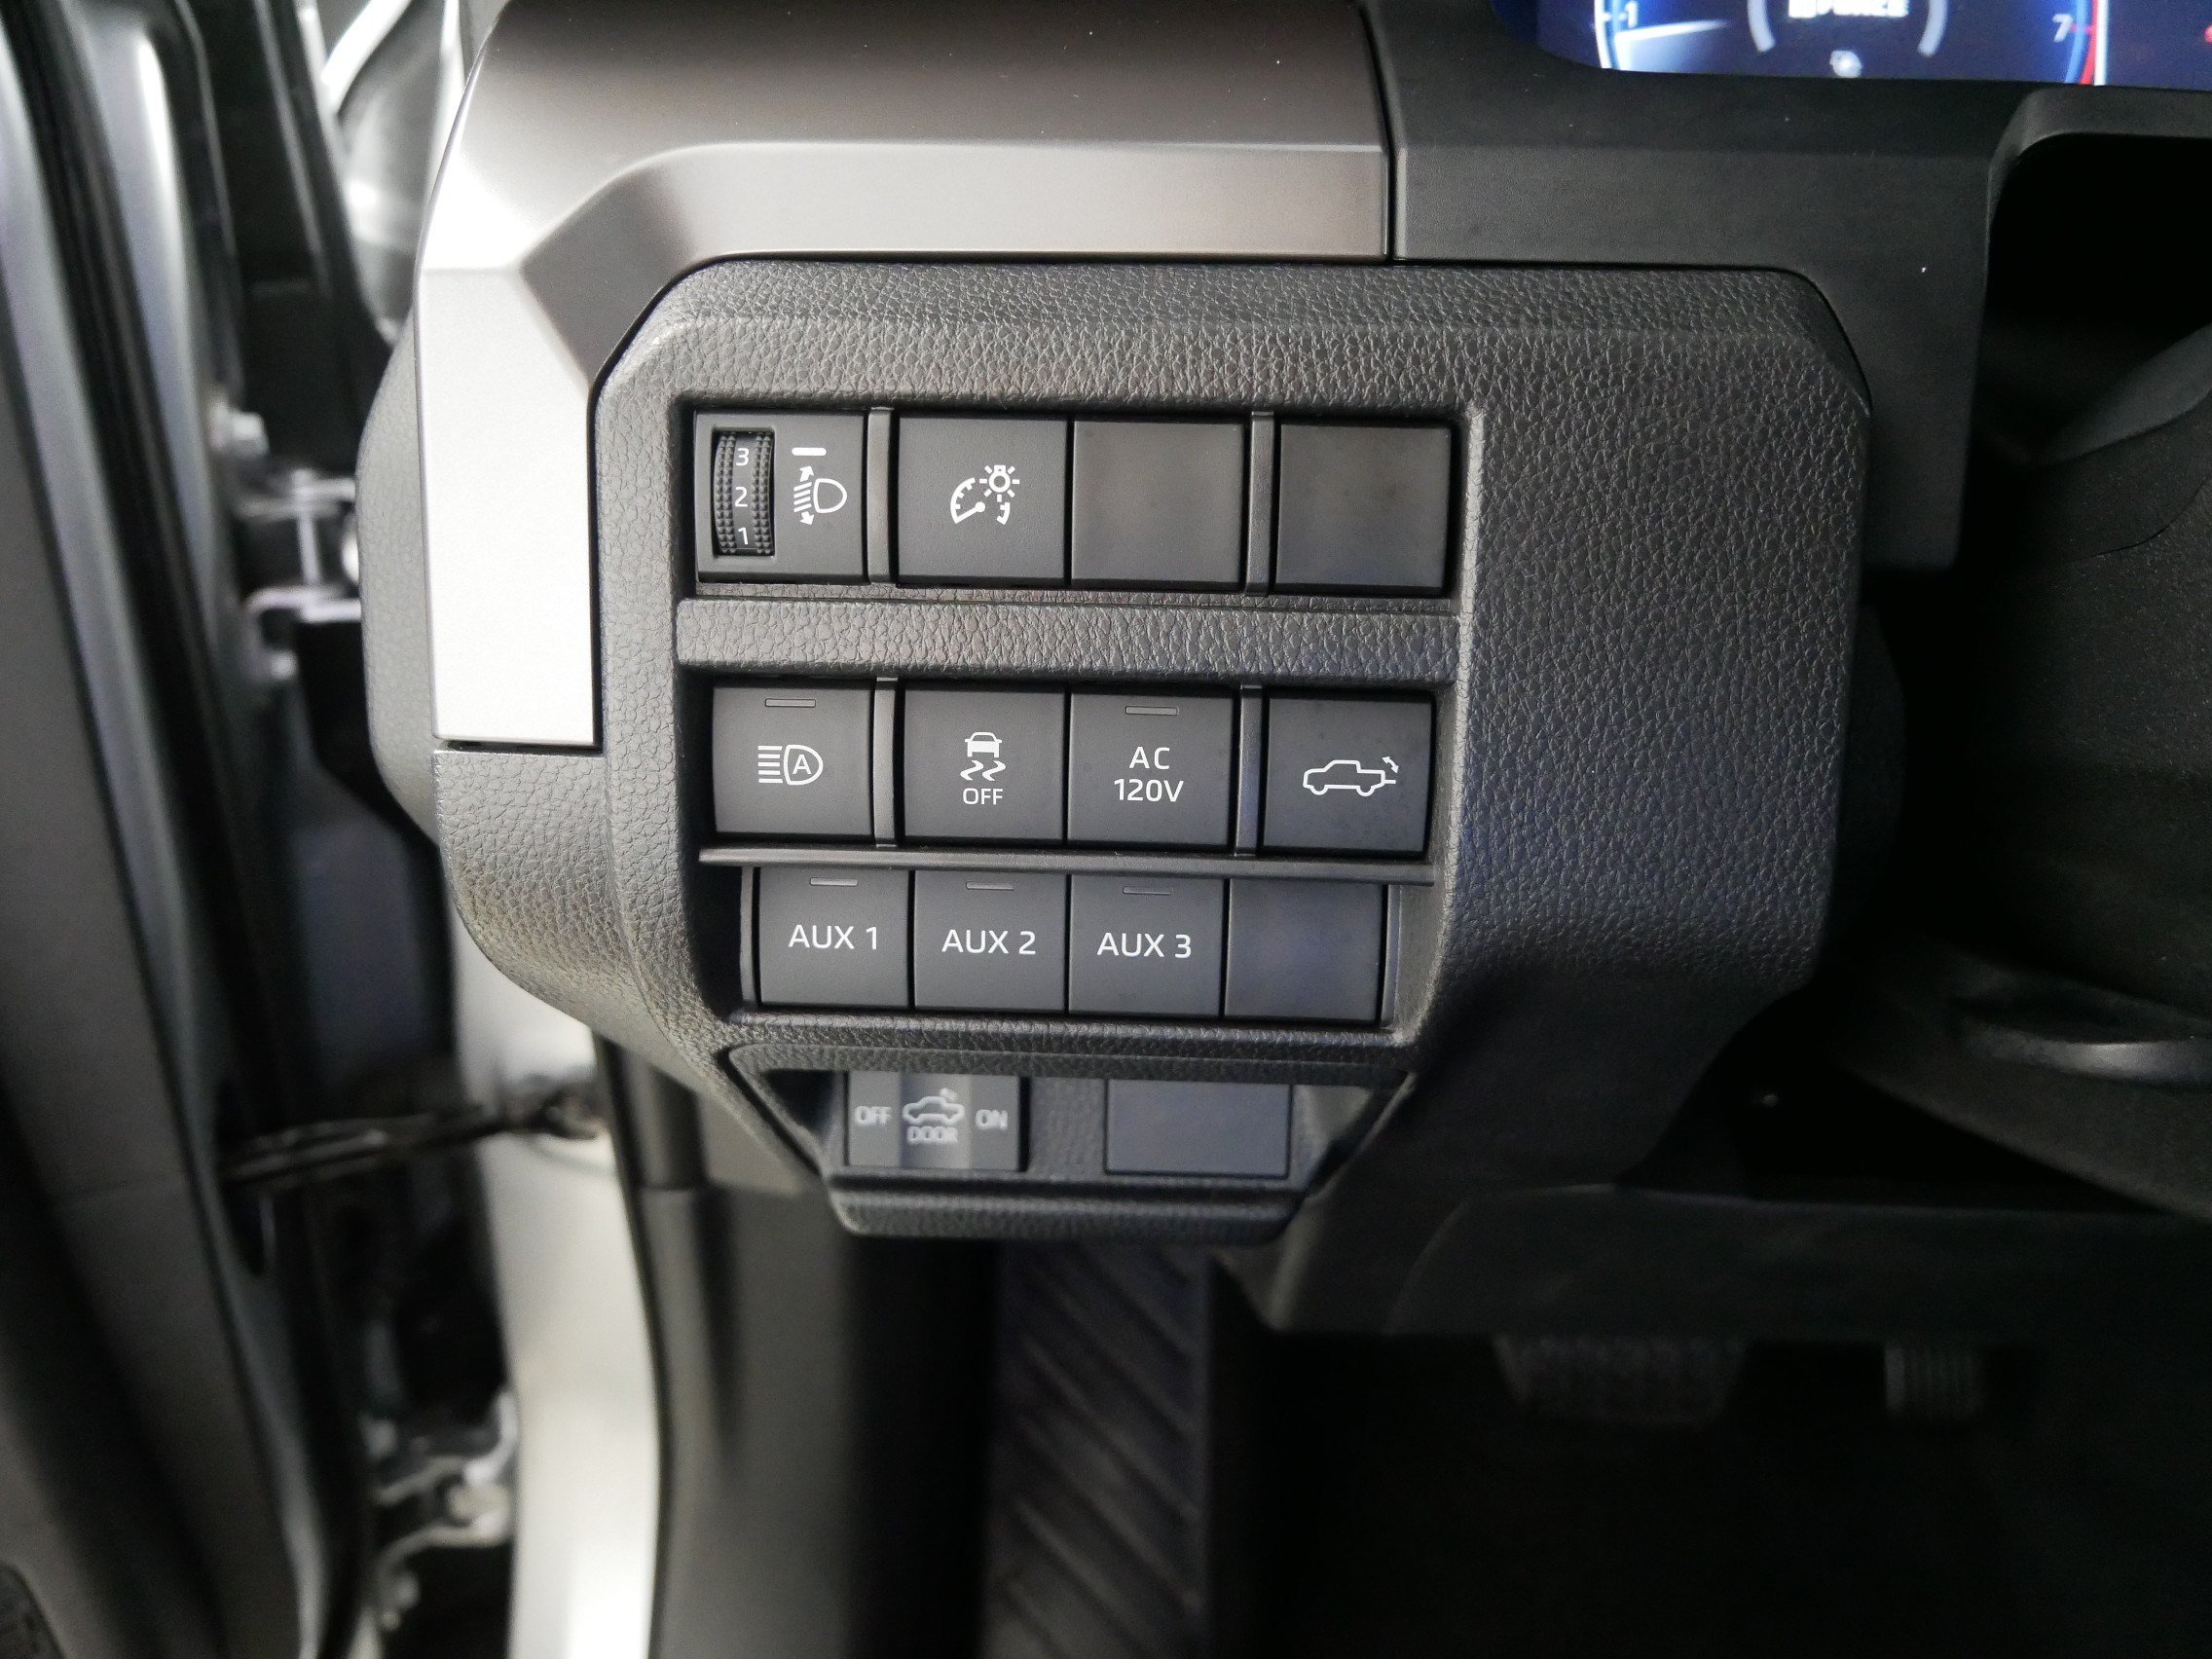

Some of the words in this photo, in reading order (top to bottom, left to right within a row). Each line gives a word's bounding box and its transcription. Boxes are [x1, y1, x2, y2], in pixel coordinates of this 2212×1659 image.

[2052, 13, 2073, 43] 7
[735, 447, 750, 466] 3
[734, 486, 749, 508] 2
[738, 527, 749, 545] 1
[792, 754, 812, 775] A
[1128, 746, 1170, 770] AC
[962, 787, 1004, 805] OFF
[1114, 778, 1184, 802] 120V
[788, 924, 854, 949] AUX
[866, 926, 877, 950] 1
[941, 929, 1009, 954] AUX
[1018, 931, 1036, 955] 2
[1096, 932, 1165, 958] AUX
[1174, 934, 1192, 959] 3
[854, 1105, 893, 1125] OFF
[976, 1109, 1009, 1129] ON
